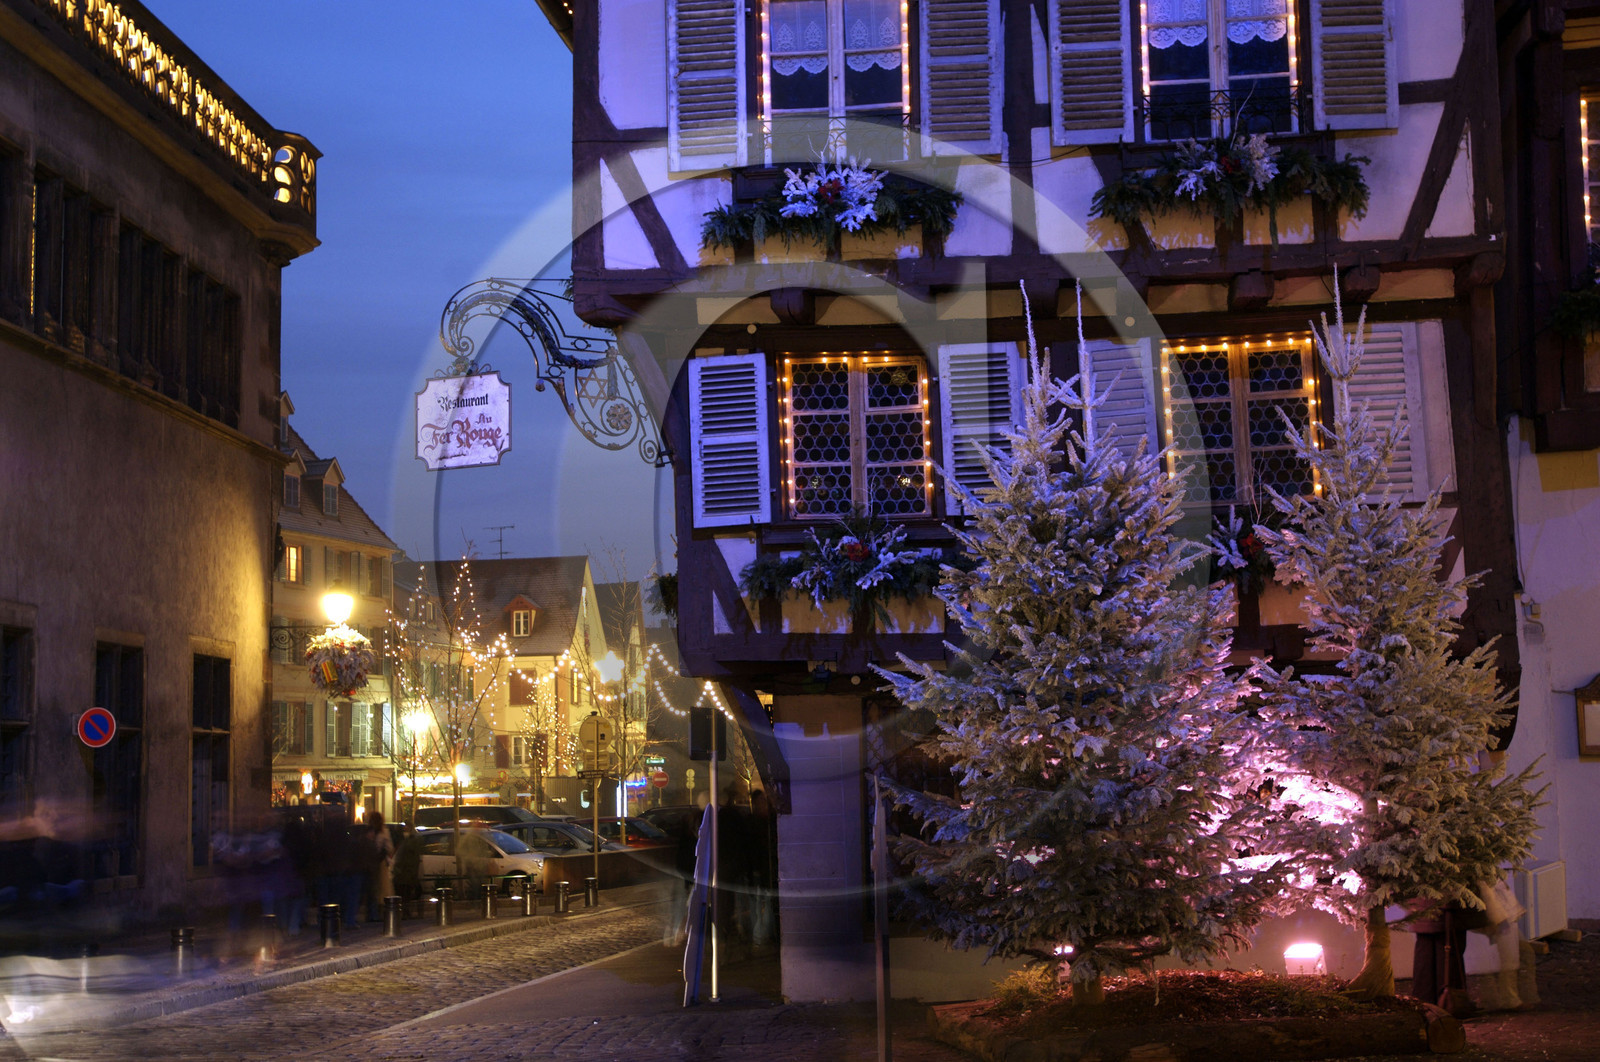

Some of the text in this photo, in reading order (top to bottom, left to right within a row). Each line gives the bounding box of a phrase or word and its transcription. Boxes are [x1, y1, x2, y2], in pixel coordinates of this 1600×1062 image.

[437, 393, 489, 412] Restaurant
[475, 413, 492, 424] Au
[421, 417, 502, 451] Fer Rouge
